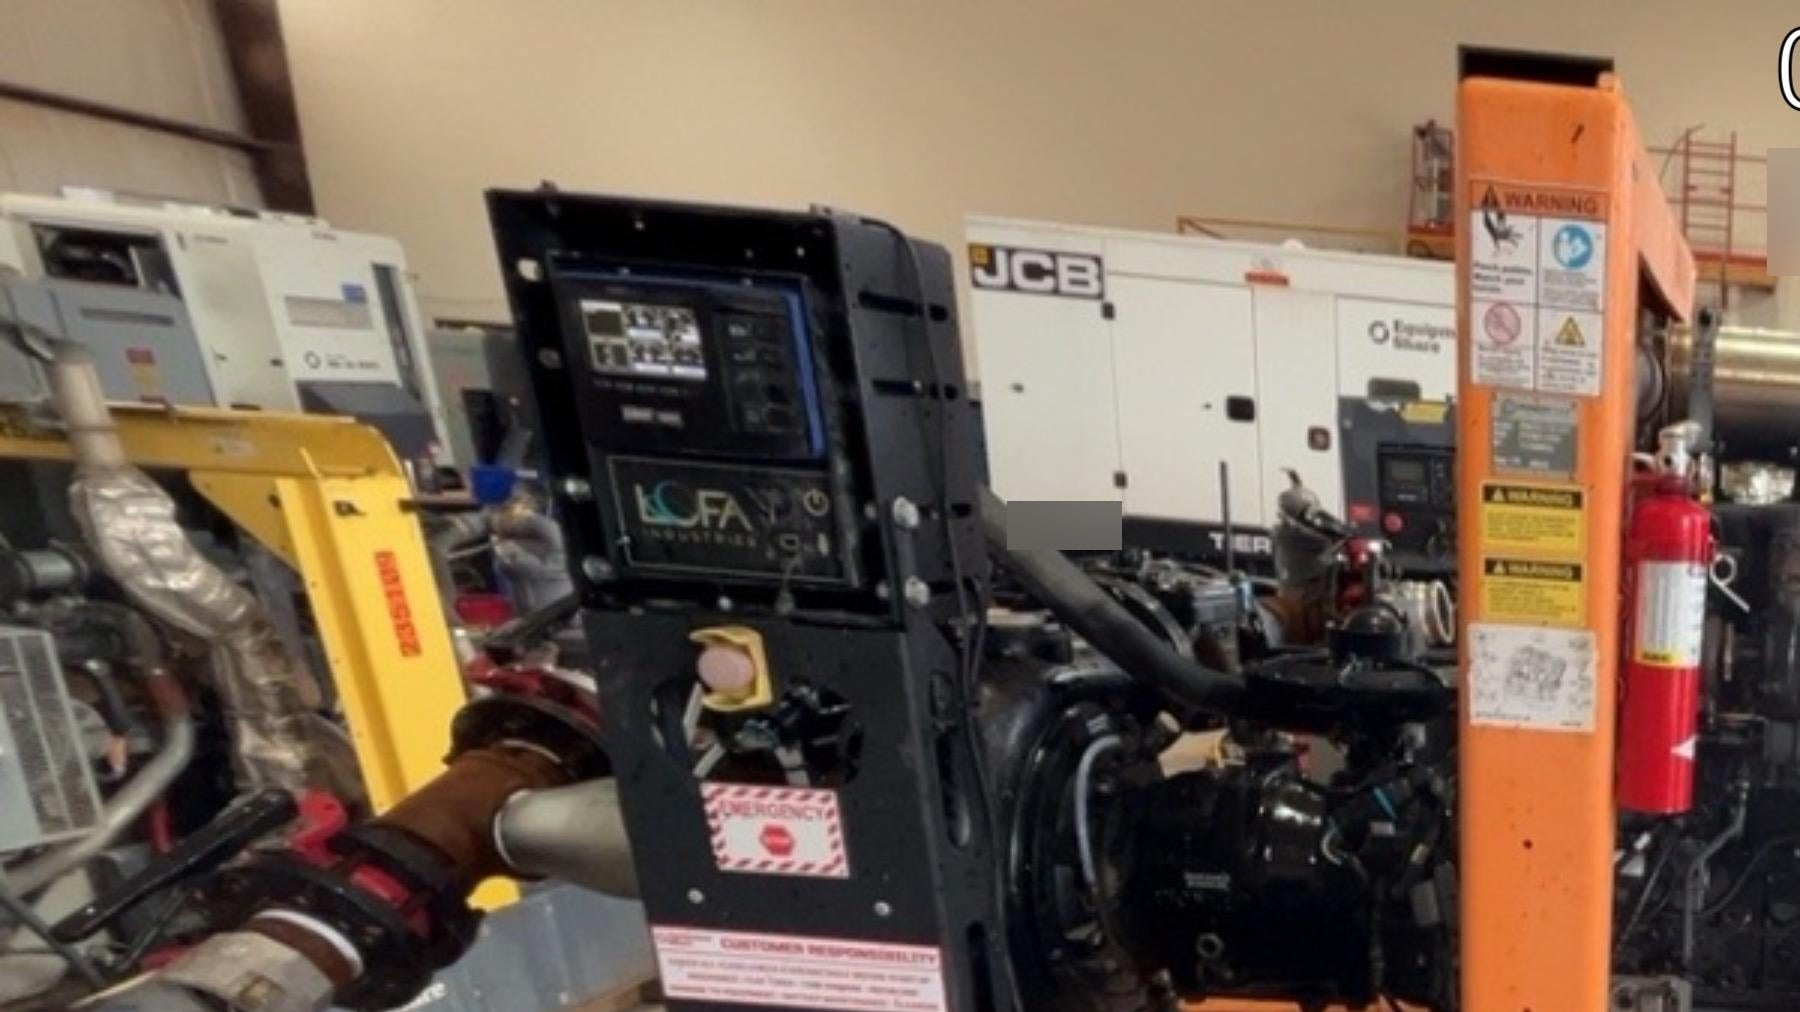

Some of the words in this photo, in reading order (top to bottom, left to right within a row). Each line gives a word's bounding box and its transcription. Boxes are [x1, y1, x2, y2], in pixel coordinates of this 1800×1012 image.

[1504, 191, 1598, 214] WARNING
[973, 248, 1102, 296] JCB
[634, 480, 754, 531] LOFA
[1207, 531, 1273, 555] TER
[719, 800, 824, 822] EMERGENCY
[719, 938, 805, 956] CUSTOMER
